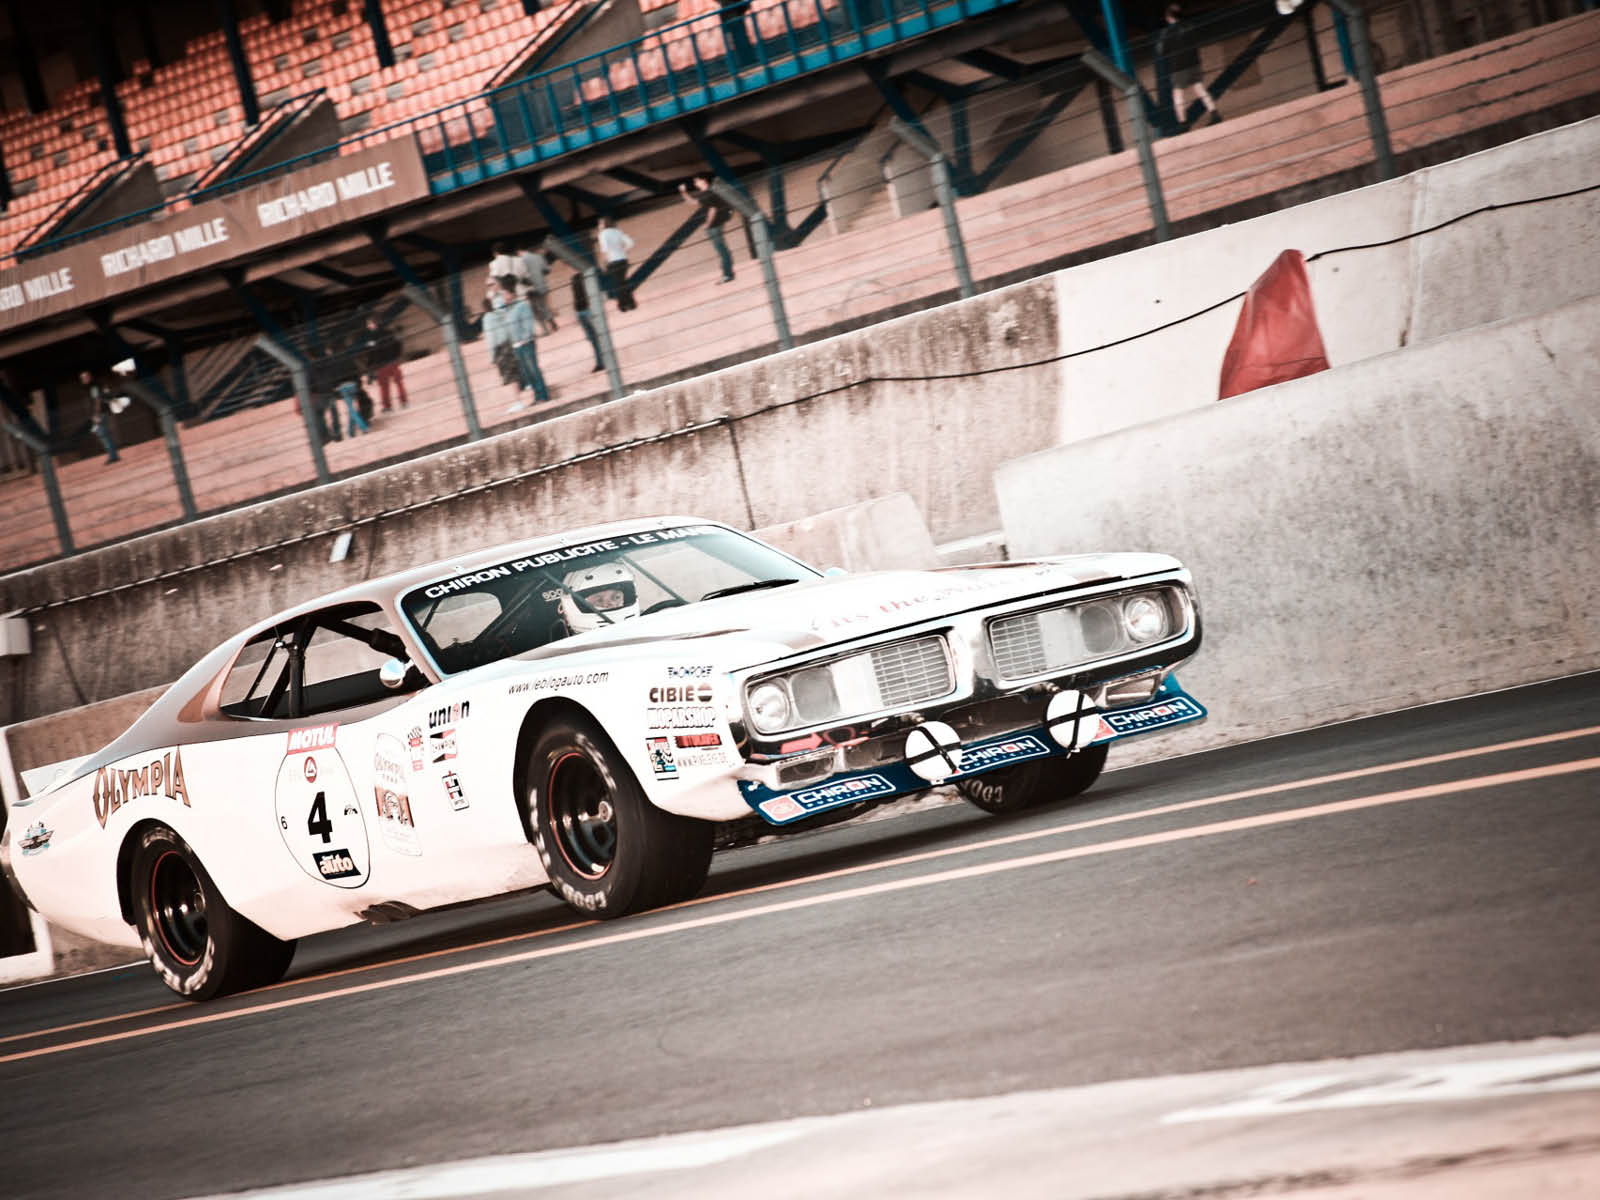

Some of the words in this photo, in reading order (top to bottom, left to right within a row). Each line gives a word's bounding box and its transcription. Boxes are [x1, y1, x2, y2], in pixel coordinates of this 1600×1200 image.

[257, 181, 337, 227] RICHARD
[336, 162, 396, 200] MILLE
[100, 235, 176, 277] RICHARD
[175, 217, 230, 253] MILLE
[23, 267, 76, 302] MILLE
[425, 566, 512, 599] CHIRON
[512, 540, 619, 572] PUBLICITE
[628, 533, 659, 545] LE
[289, 725, 336, 750] MOTUL
[93, 745, 192, 829] OLYMPIA
[280, 816, 289, 830] 6
[307, 791, 334, 844] 4
[319, 853, 354, 875] auto
